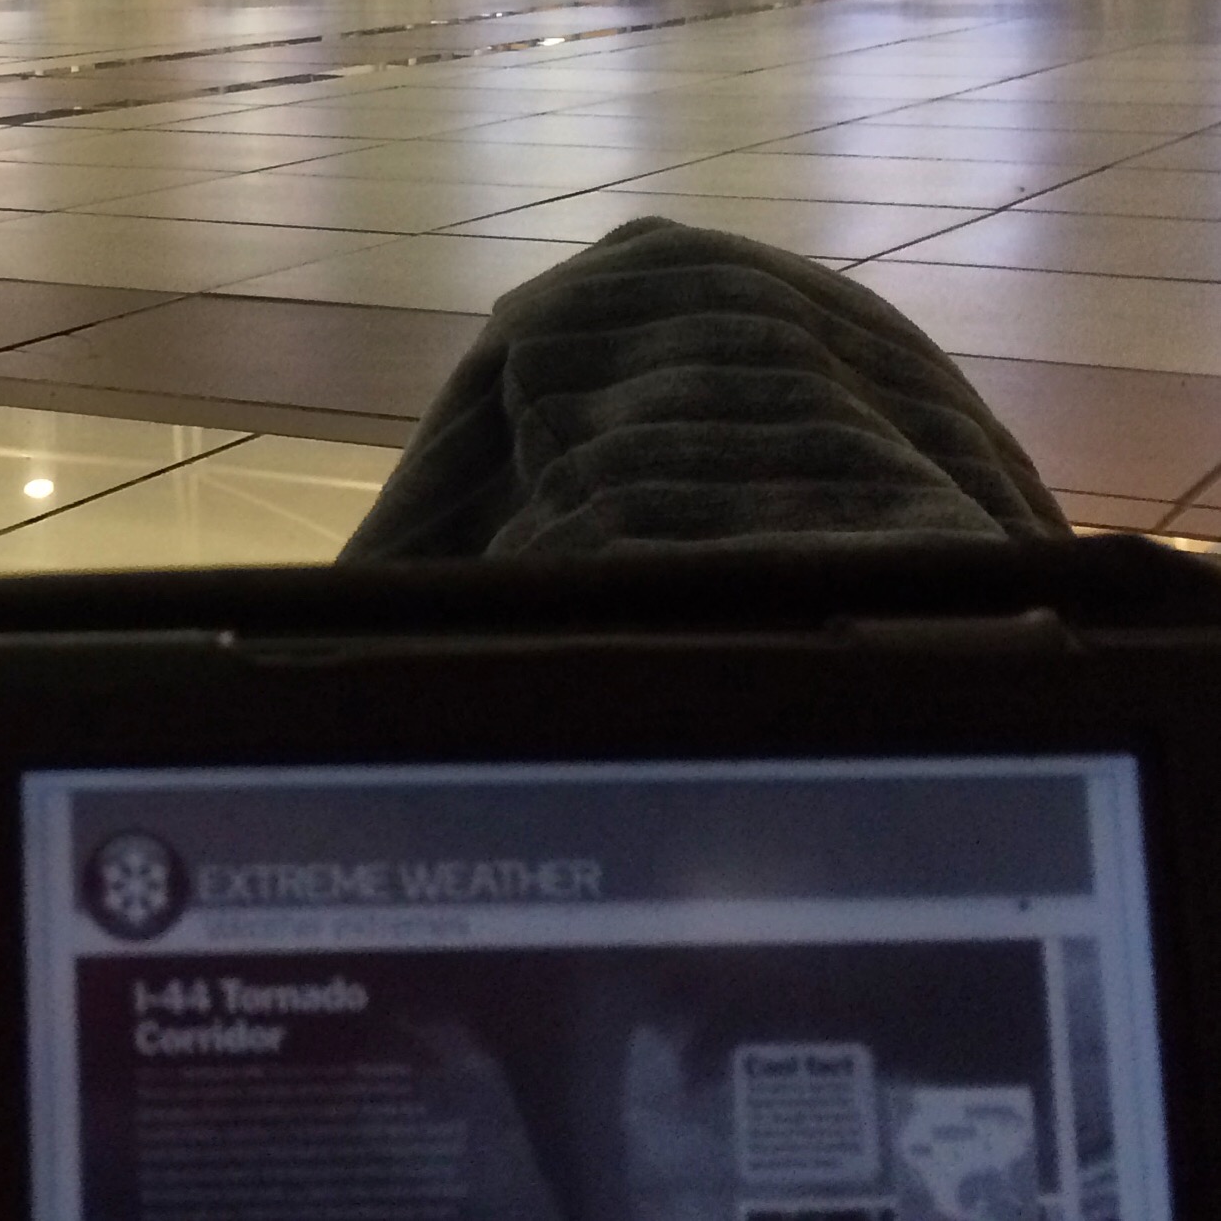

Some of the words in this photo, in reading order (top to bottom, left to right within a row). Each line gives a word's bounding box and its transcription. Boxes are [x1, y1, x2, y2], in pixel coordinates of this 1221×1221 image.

[197, 861, 388, 901] EXTREME
[400, 858, 603, 900] WEATHER
[219, 975, 368, 1014] Tornado
[134, 1018, 288, 1056] Corridor
